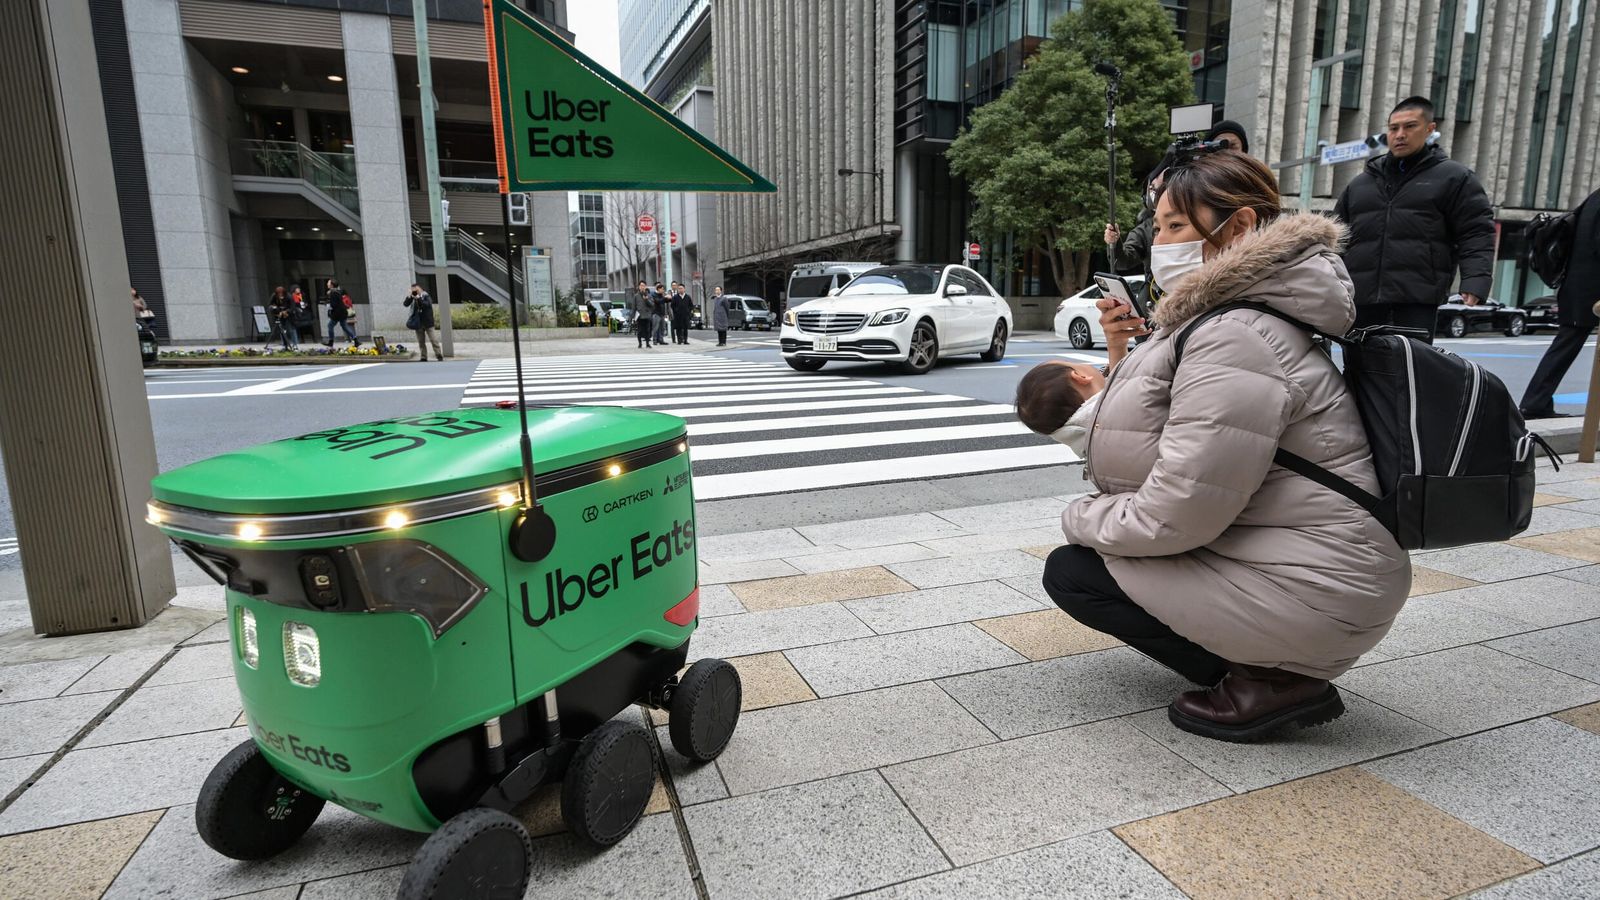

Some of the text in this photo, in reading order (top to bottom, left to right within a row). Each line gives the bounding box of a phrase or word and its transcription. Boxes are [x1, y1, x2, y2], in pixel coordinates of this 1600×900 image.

[525, 90, 611, 122] Uber
[527, 127, 614, 158] Eats
[603, 488, 653, 513] CARTKEN
[520, 520, 693, 627] Uber Eats
[288, 734, 351, 773] Eats
